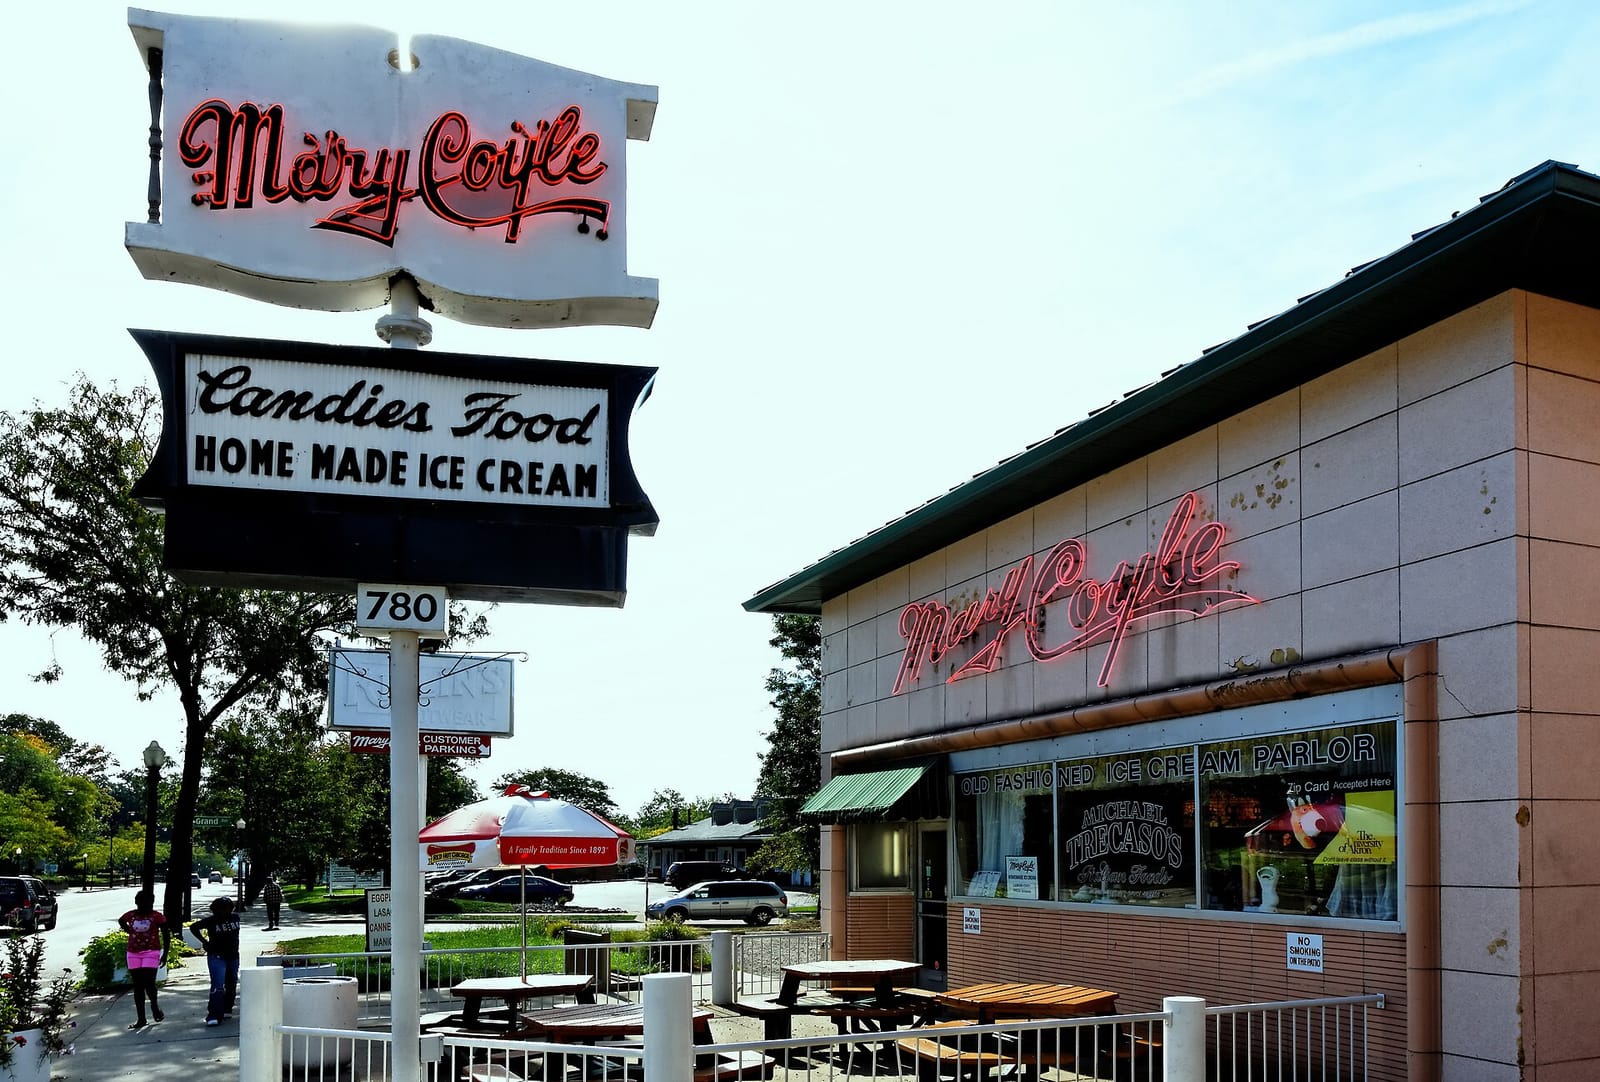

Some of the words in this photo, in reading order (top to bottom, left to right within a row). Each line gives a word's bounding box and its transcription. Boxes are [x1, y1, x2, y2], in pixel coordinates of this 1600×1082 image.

[177, 99, 416, 248] Mary
[418, 106, 611, 243] Coyle
[196, 365, 433, 432] Candies
[451, 392, 600, 445] Food
[195, 434, 294, 478] HOME
[311, 443, 407, 486] MADE
[418, 452, 465, 490] ICE
[476, 458, 597, 498] CREAM
[892, 555, 1033, 694] Mary
[1024, 491, 1260, 687] Coyle
[366, 590, 437, 622] 780
[353, 735, 390, 748] Mary
[423, 735, 481, 745] CUSTOMER
[424, 745, 477, 754] PARKING
[961, 776, 990, 796] OLD
[994, 765, 1095, 792] FASHIONED
[1105, 760, 1142, 784] ICE
[1147, 749, 1241, 780] CREAM
[1253, 733, 1376, 771] PARLOR
[1287, 782, 1301, 794] Zip
[1304, 781, 1329, 792] Card
[1333, 778, 1368, 789] Accepted
[1370, 778, 1391, 786] Here
[1082, 800, 1168, 829] MICHAEL
[1357, 830, 1373, 841] The
[509, 846, 514, 854] A
[515, 845, 537, 855] Family
[539, 845, 568, 854] Tradition
[570, 845, 587, 854] Since
[1066, 821, 1182, 870] TRECASO'S
[1128, 864, 1173, 885] Foods
[371, 893, 391, 903] EGGPL
[373, 908, 391, 918] LASA
[369, 922, 391, 932] CANNE
[1297, 937, 1310, 946] NO
[1290, 946, 1321, 957] SMOKING
[1290, 957, 1297, 965] ON
[1298, 957, 1306, 965] THE
[1307, 958, 1321, 967] PATIO
